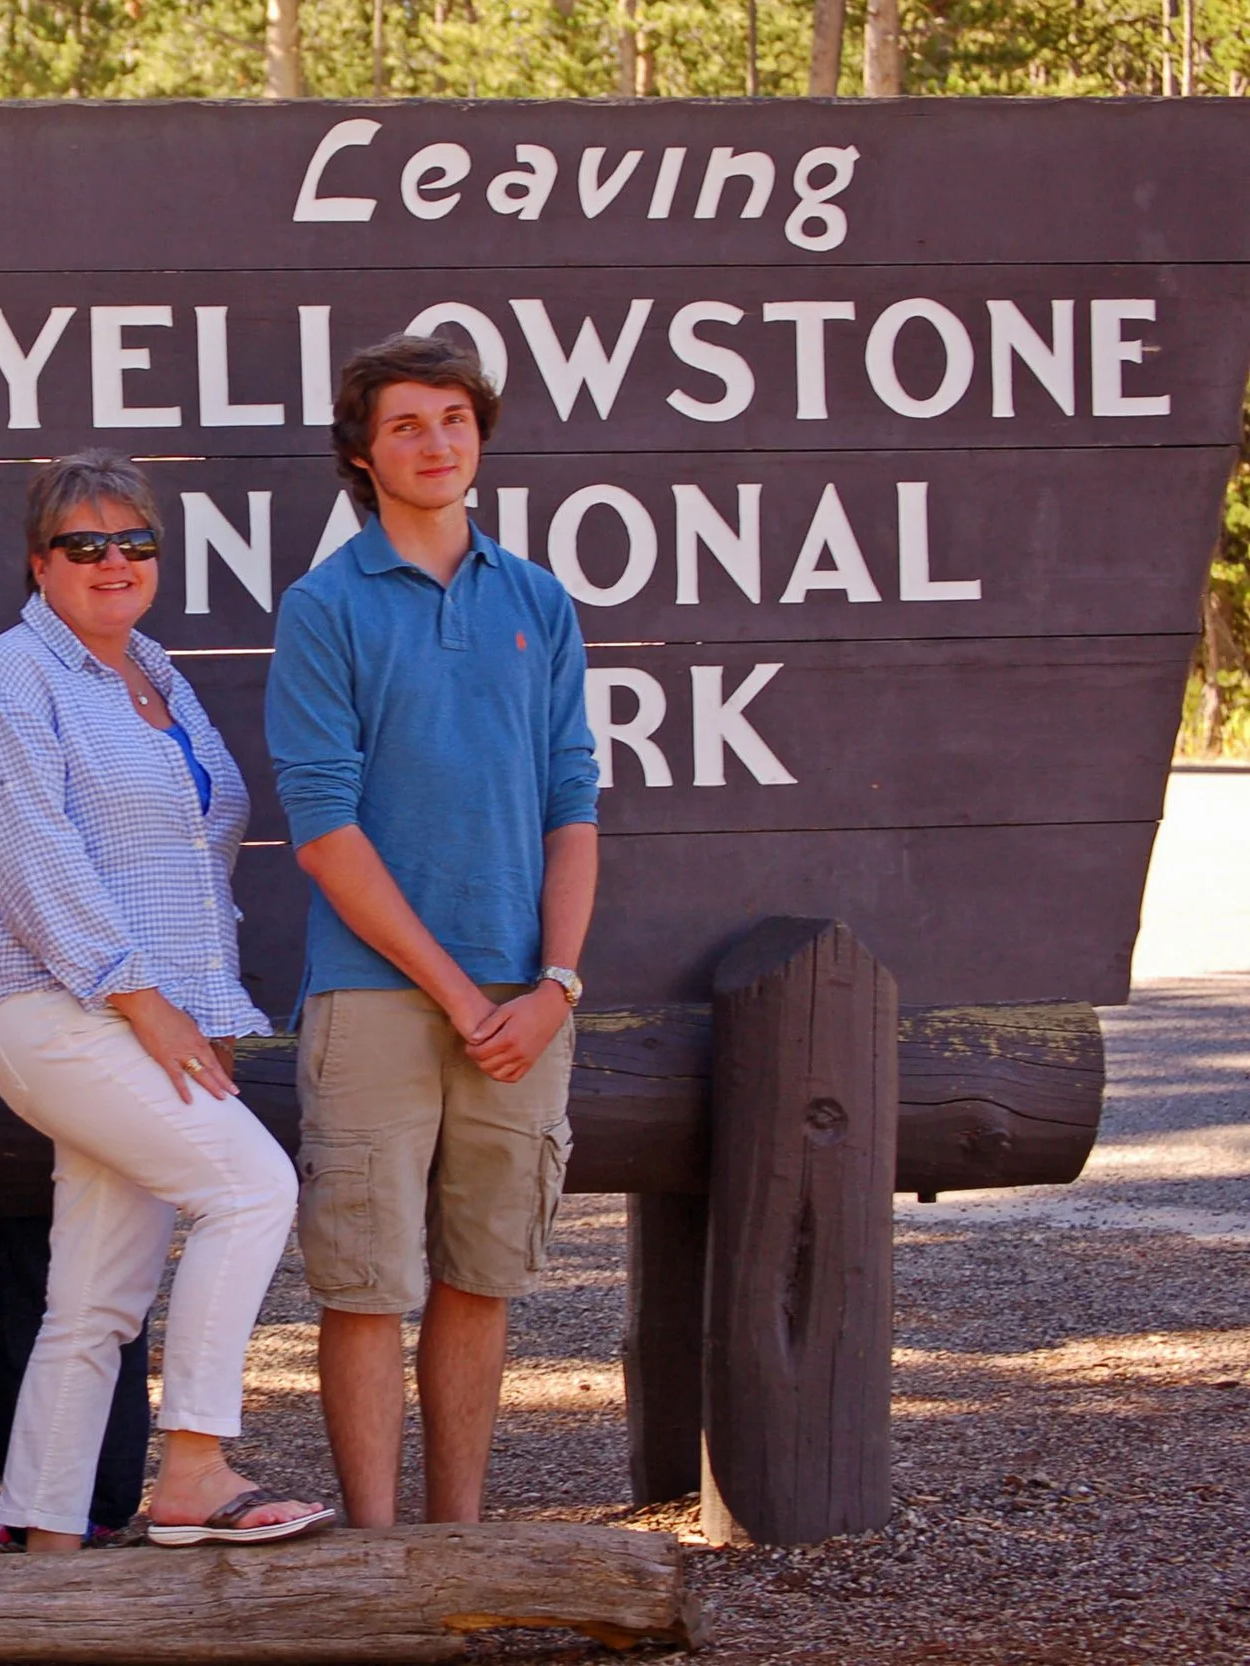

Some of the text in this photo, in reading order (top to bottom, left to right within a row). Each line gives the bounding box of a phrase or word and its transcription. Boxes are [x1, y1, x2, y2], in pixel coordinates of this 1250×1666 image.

[292, 118, 860, 252] Leaving
[180, 481, 982, 614] NIONAL
[583, 662, 799, 789] RK
